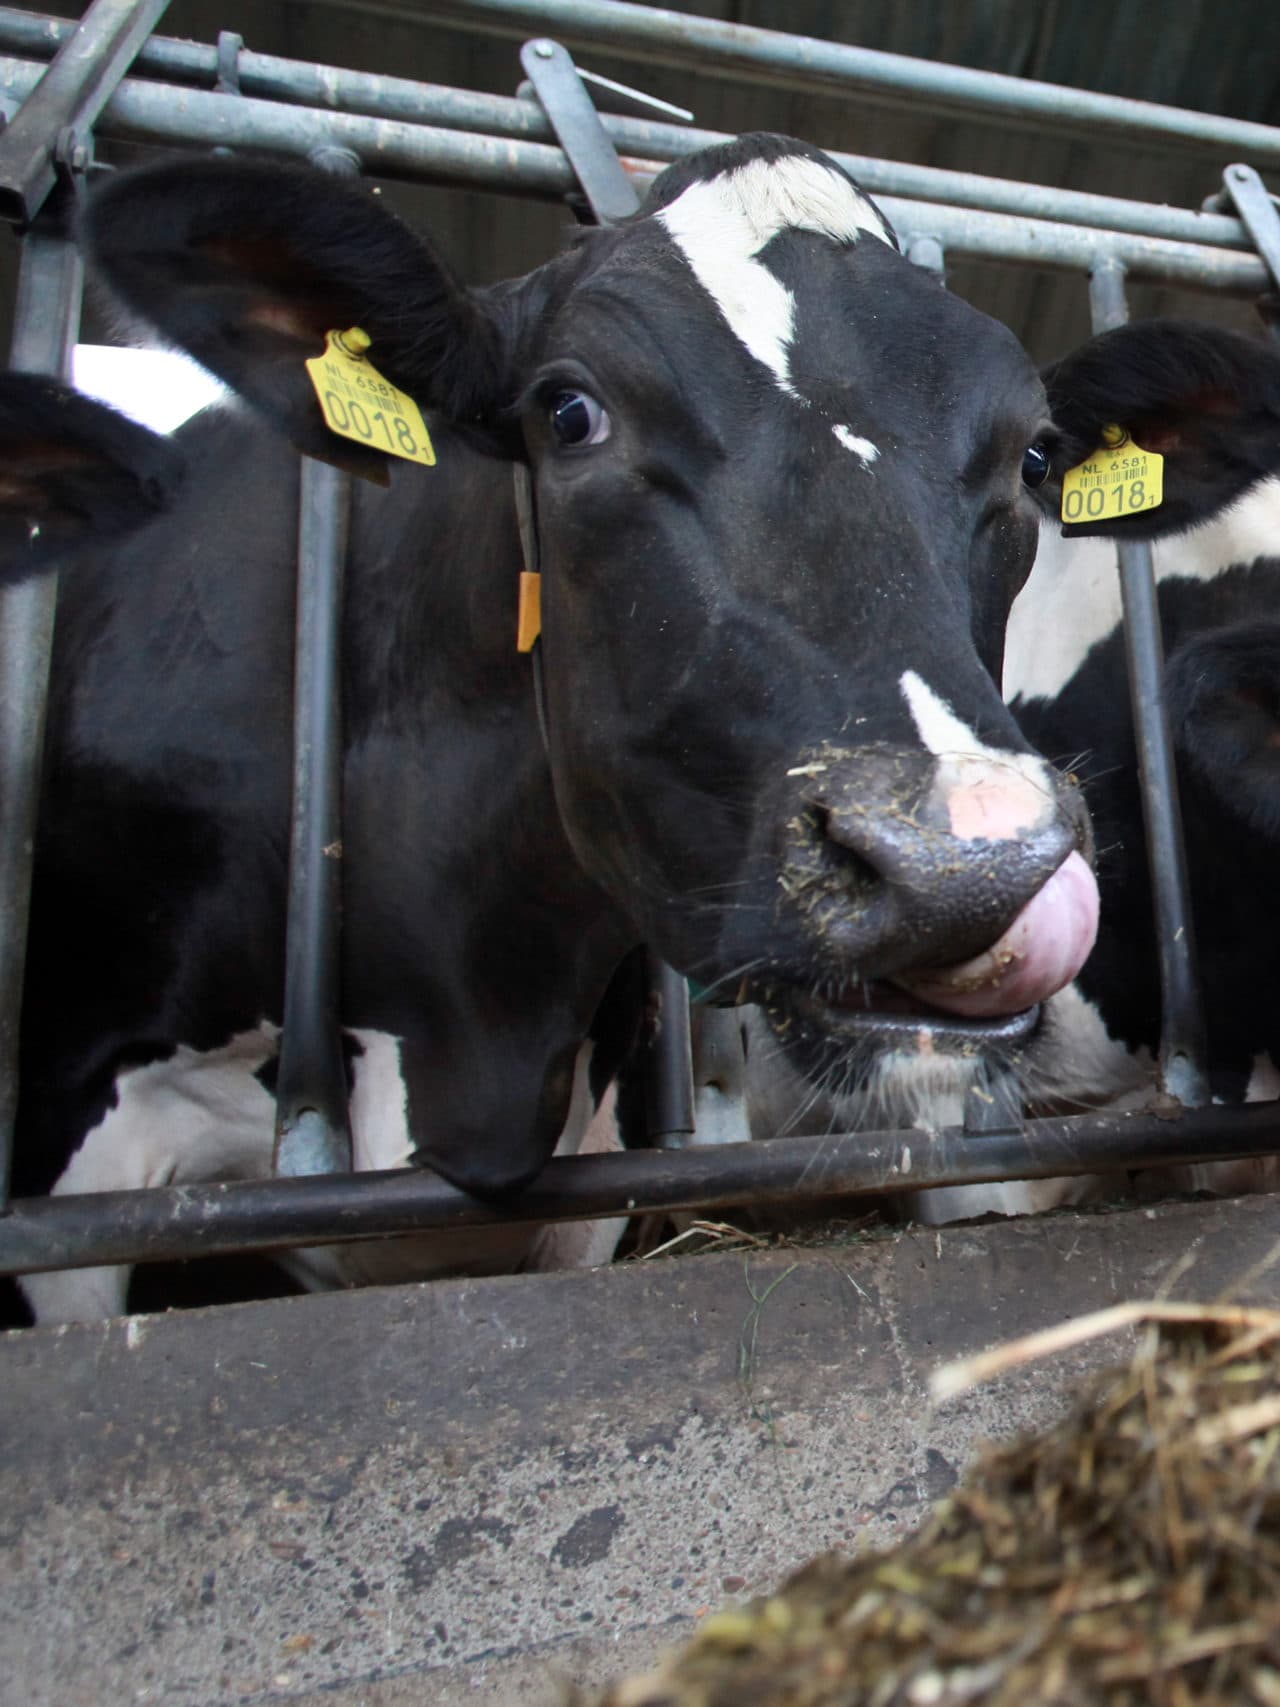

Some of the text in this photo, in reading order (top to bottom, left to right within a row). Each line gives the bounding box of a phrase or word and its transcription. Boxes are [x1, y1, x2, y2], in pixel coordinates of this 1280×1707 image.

[325, 362, 348, 381] NL
[325, 390, 417, 455] 0018
[1083, 456, 1147, 474] NL 6581
[1065, 481, 1145, 518] 0018
